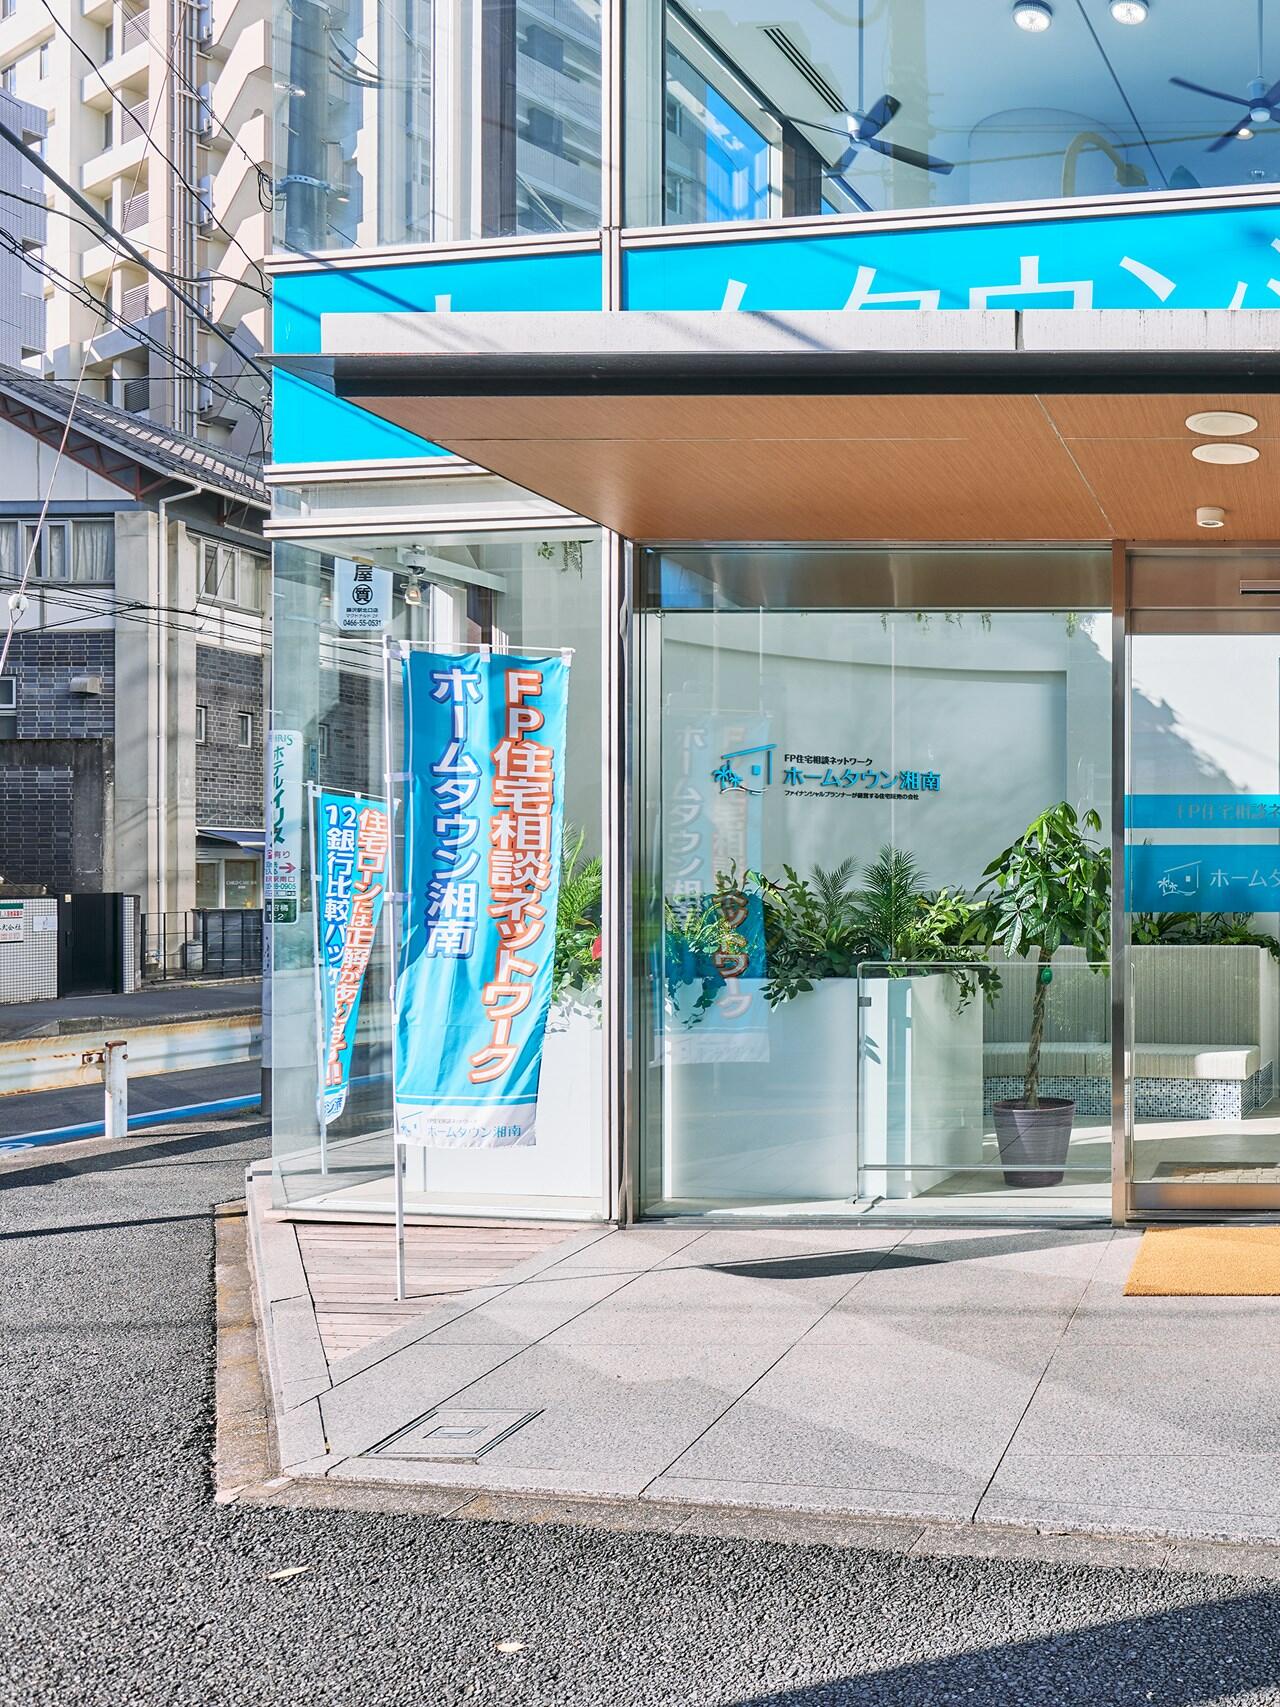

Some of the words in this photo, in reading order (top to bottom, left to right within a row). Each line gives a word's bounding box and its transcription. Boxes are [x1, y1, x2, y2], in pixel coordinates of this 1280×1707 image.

[427, 667, 484, 960] ホームタウン湘南
[783, 766, 942, 791] ホームタウン湘南
[784, 754, 873, 766] FP住宅相談ネットワーク
[468, 669, 555, 1084] FP住宅相談ネットワーク
